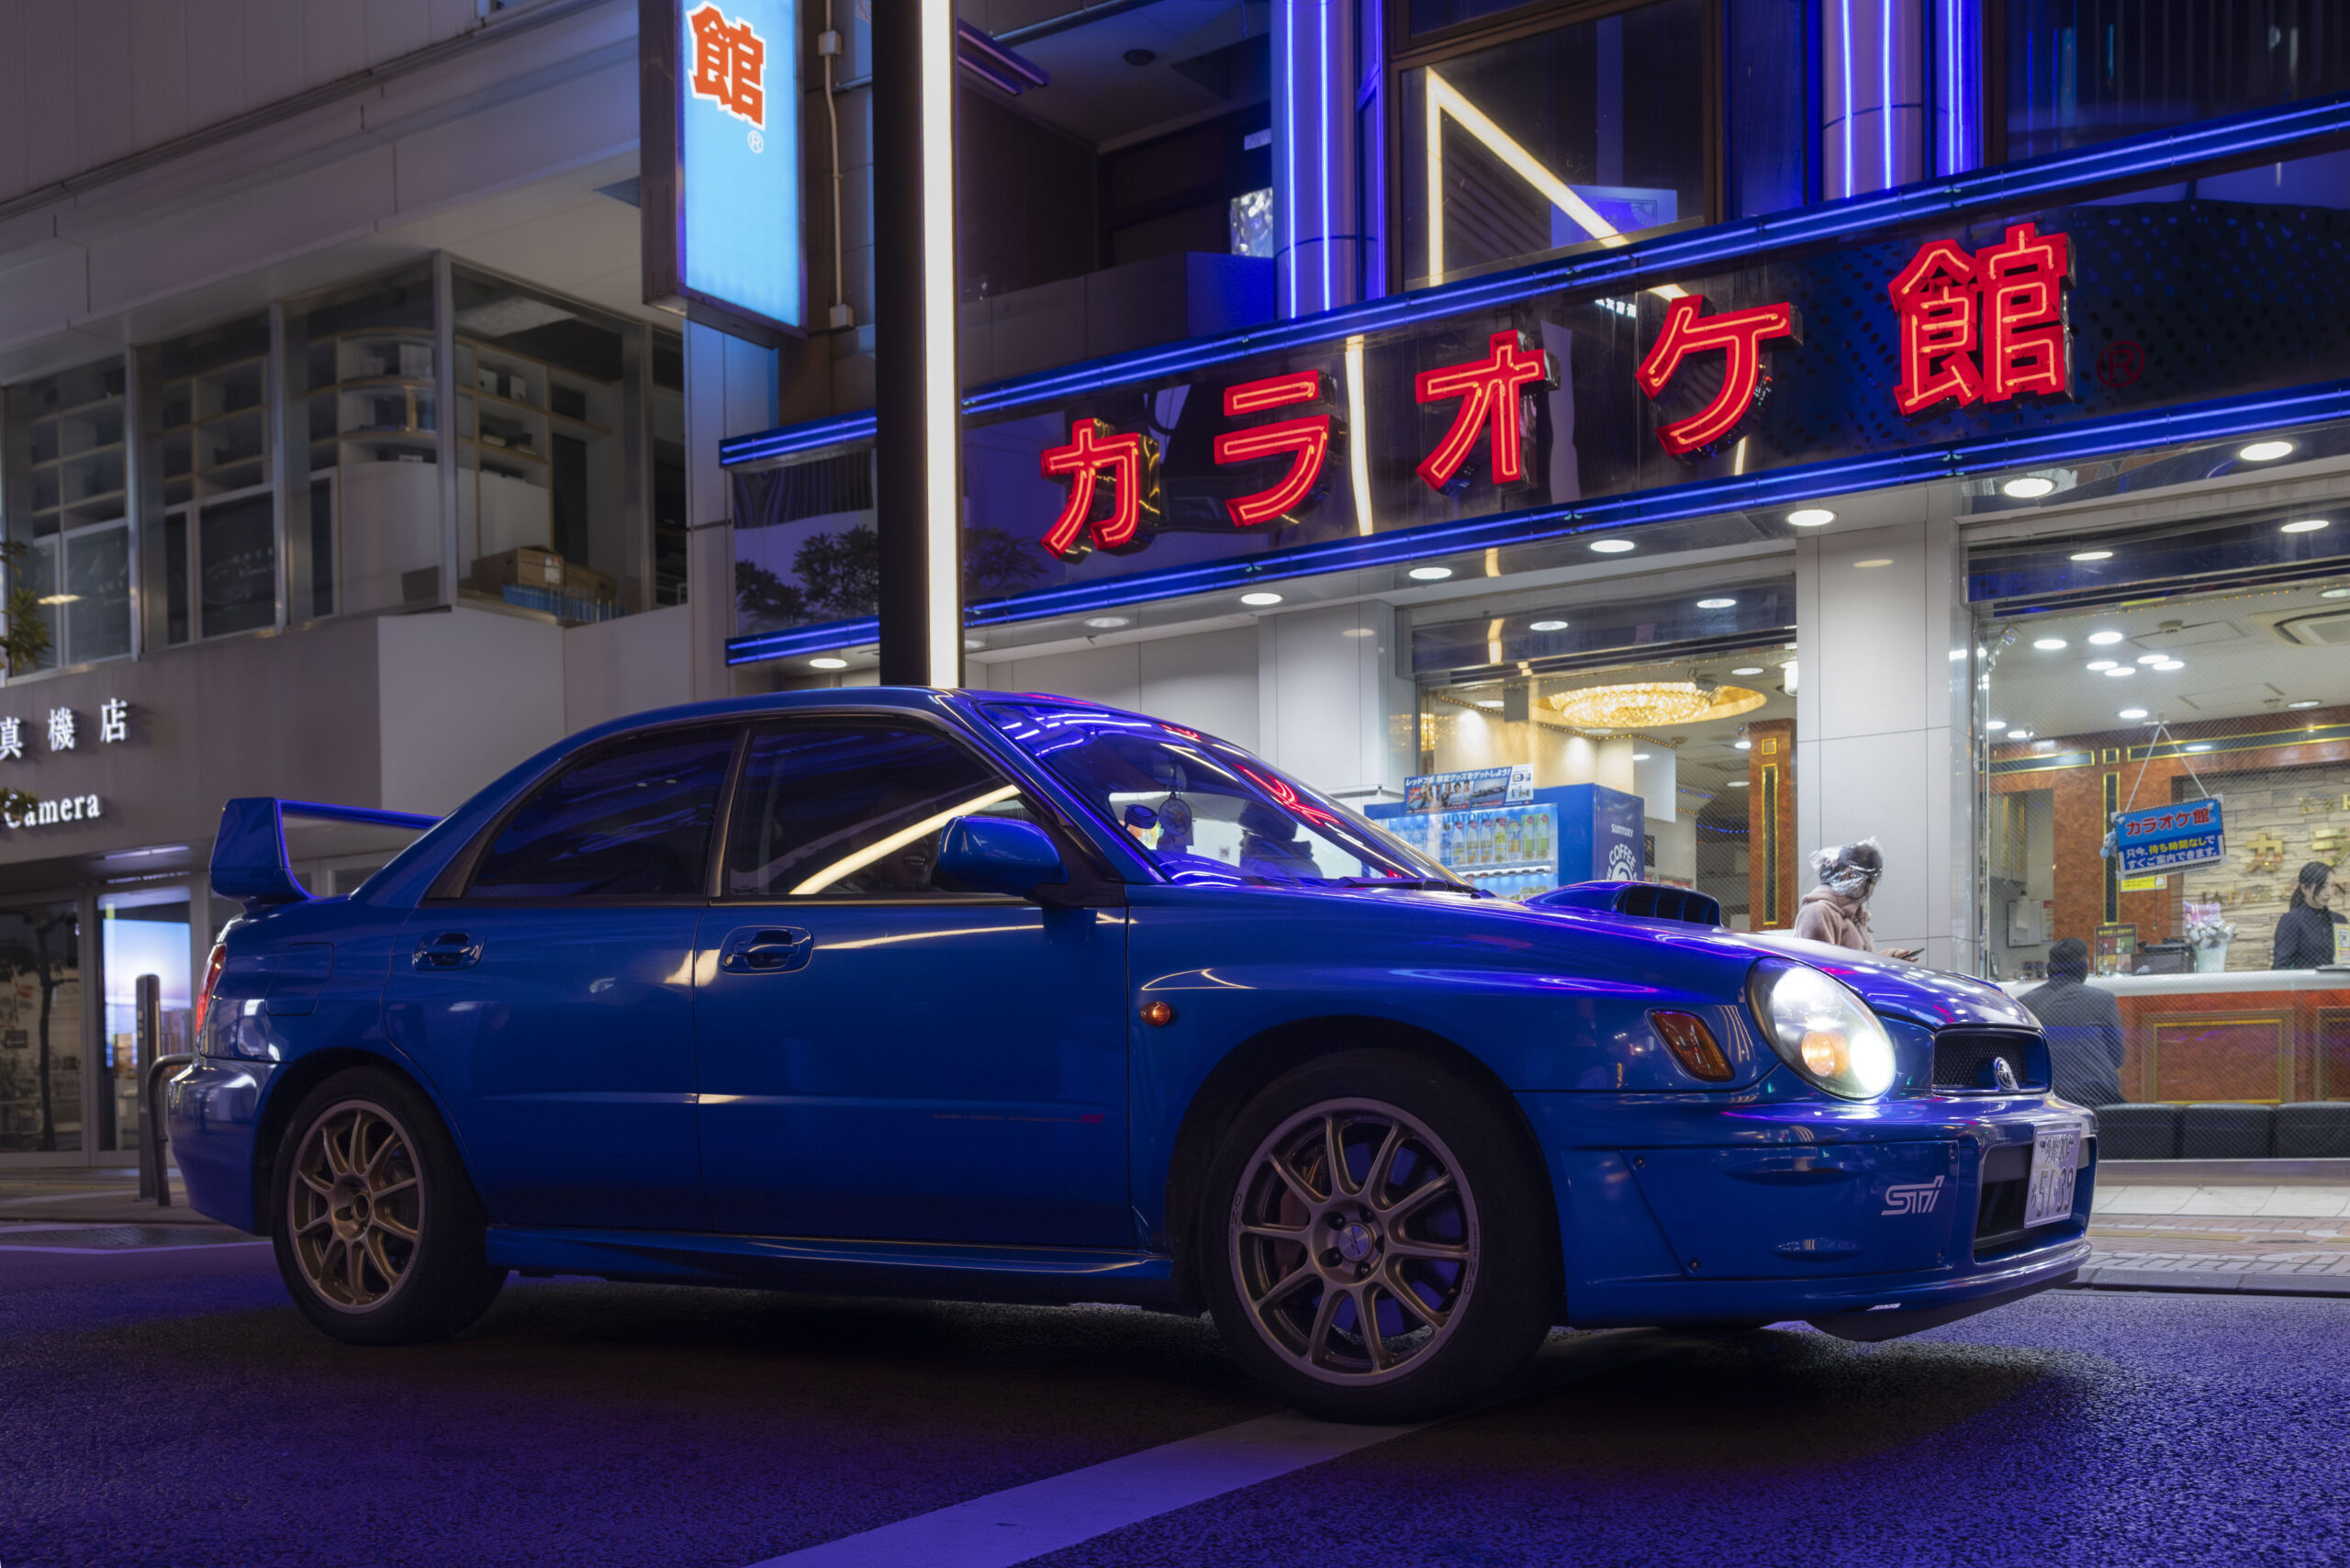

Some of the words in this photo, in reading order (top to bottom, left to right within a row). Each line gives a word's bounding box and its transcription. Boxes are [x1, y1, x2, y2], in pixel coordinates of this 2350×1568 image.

[687, 2, 766, 130] 館
[1041, 222, 2071, 558] カラオケ館
[0, 698, 128, 760] 真機店
[2126, 808, 2210, 836] カラオケ館
[1609, 844, 1636, 871] COFFEE
